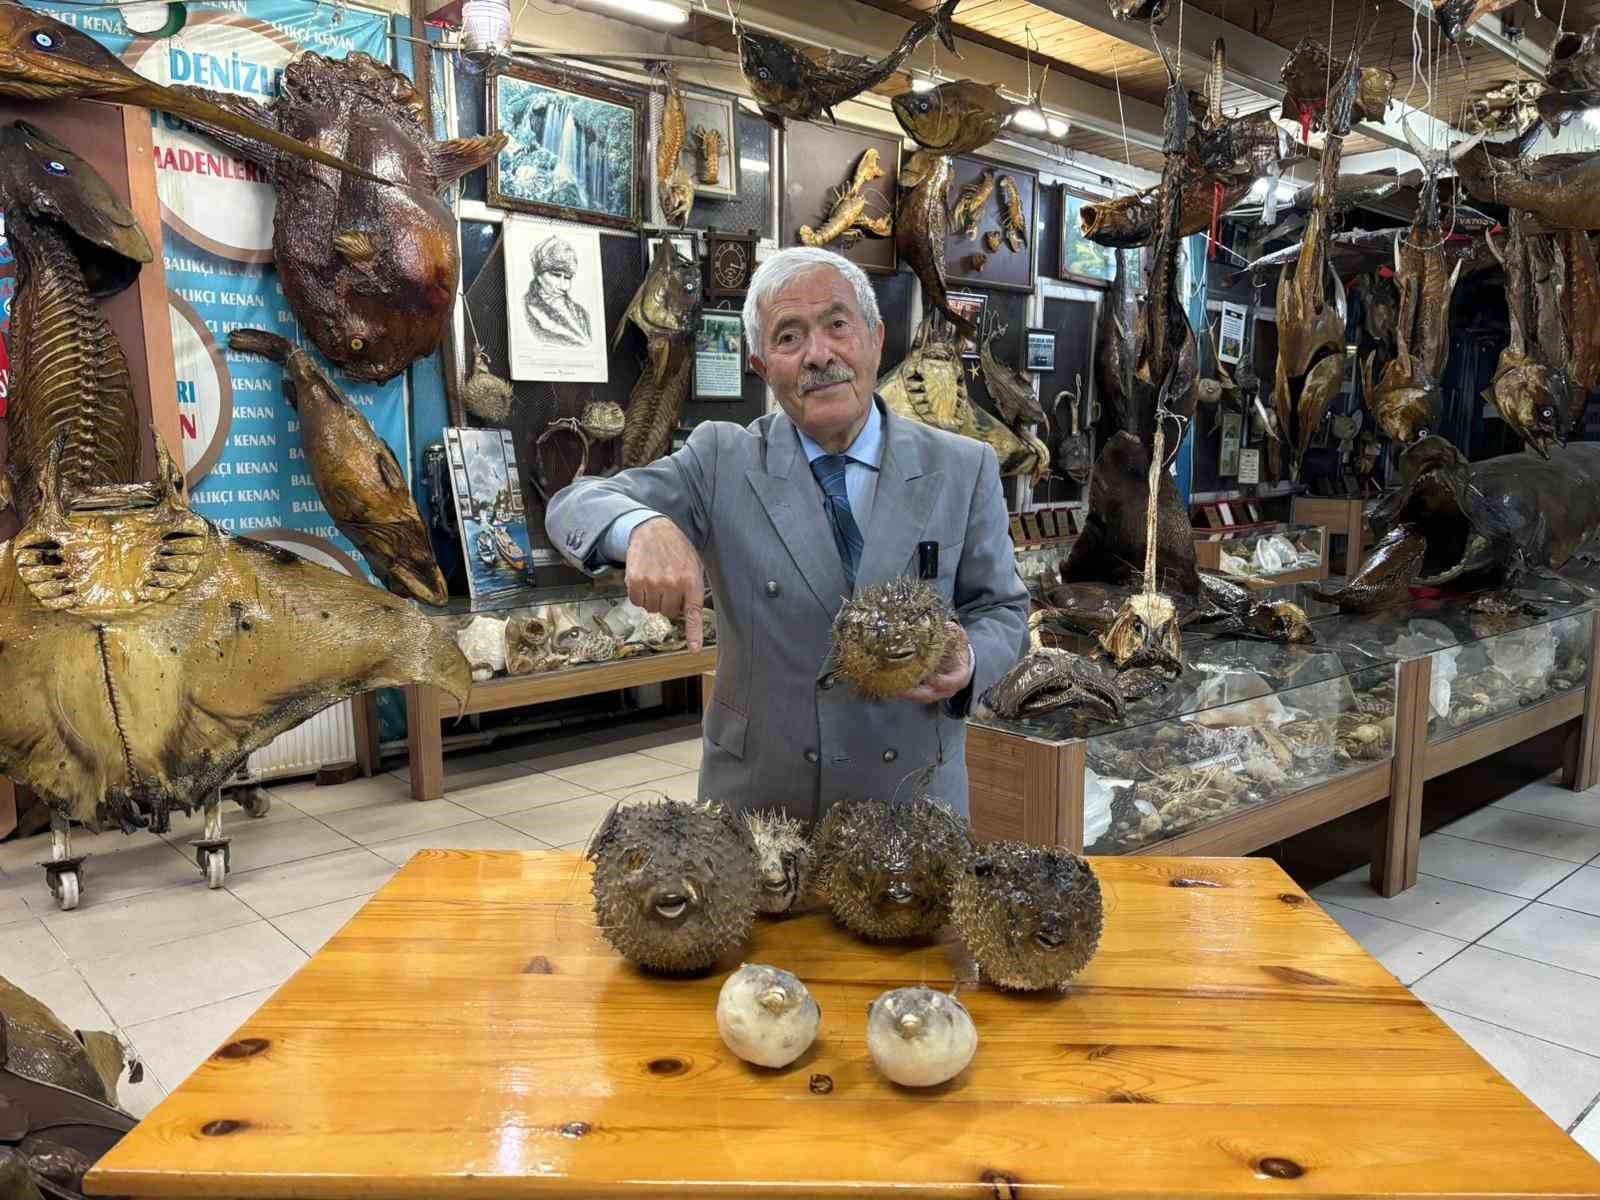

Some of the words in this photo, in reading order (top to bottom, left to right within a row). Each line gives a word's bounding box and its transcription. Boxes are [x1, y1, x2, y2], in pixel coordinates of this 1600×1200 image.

[220, 291, 264, 307] KENAN
[230, 377, 272, 392] KENAN
[232, 405, 274, 420] KENAN
[233, 433, 277, 448] KENAN
[235, 461, 279, 475] KENAN
[237, 488, 280, 503] KENAN
[239, 514, 282, 530] KENAN
